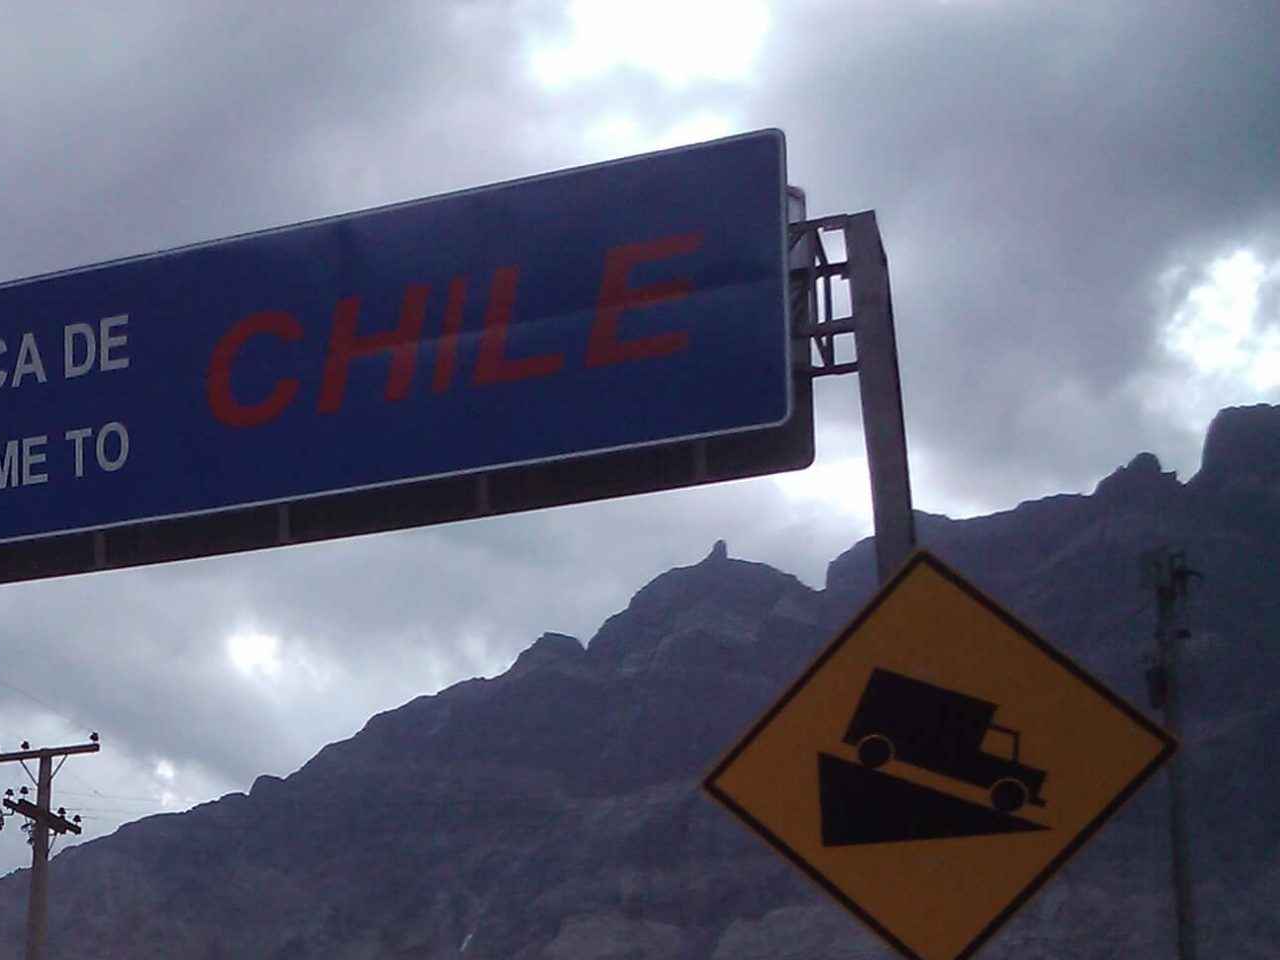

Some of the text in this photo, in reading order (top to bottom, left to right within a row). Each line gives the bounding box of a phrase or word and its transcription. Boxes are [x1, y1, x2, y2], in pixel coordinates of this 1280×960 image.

[64, 314, 130, 376] DE
[205, 230, 705, 428] CHILE
[66, 421, 130, 477] TO
